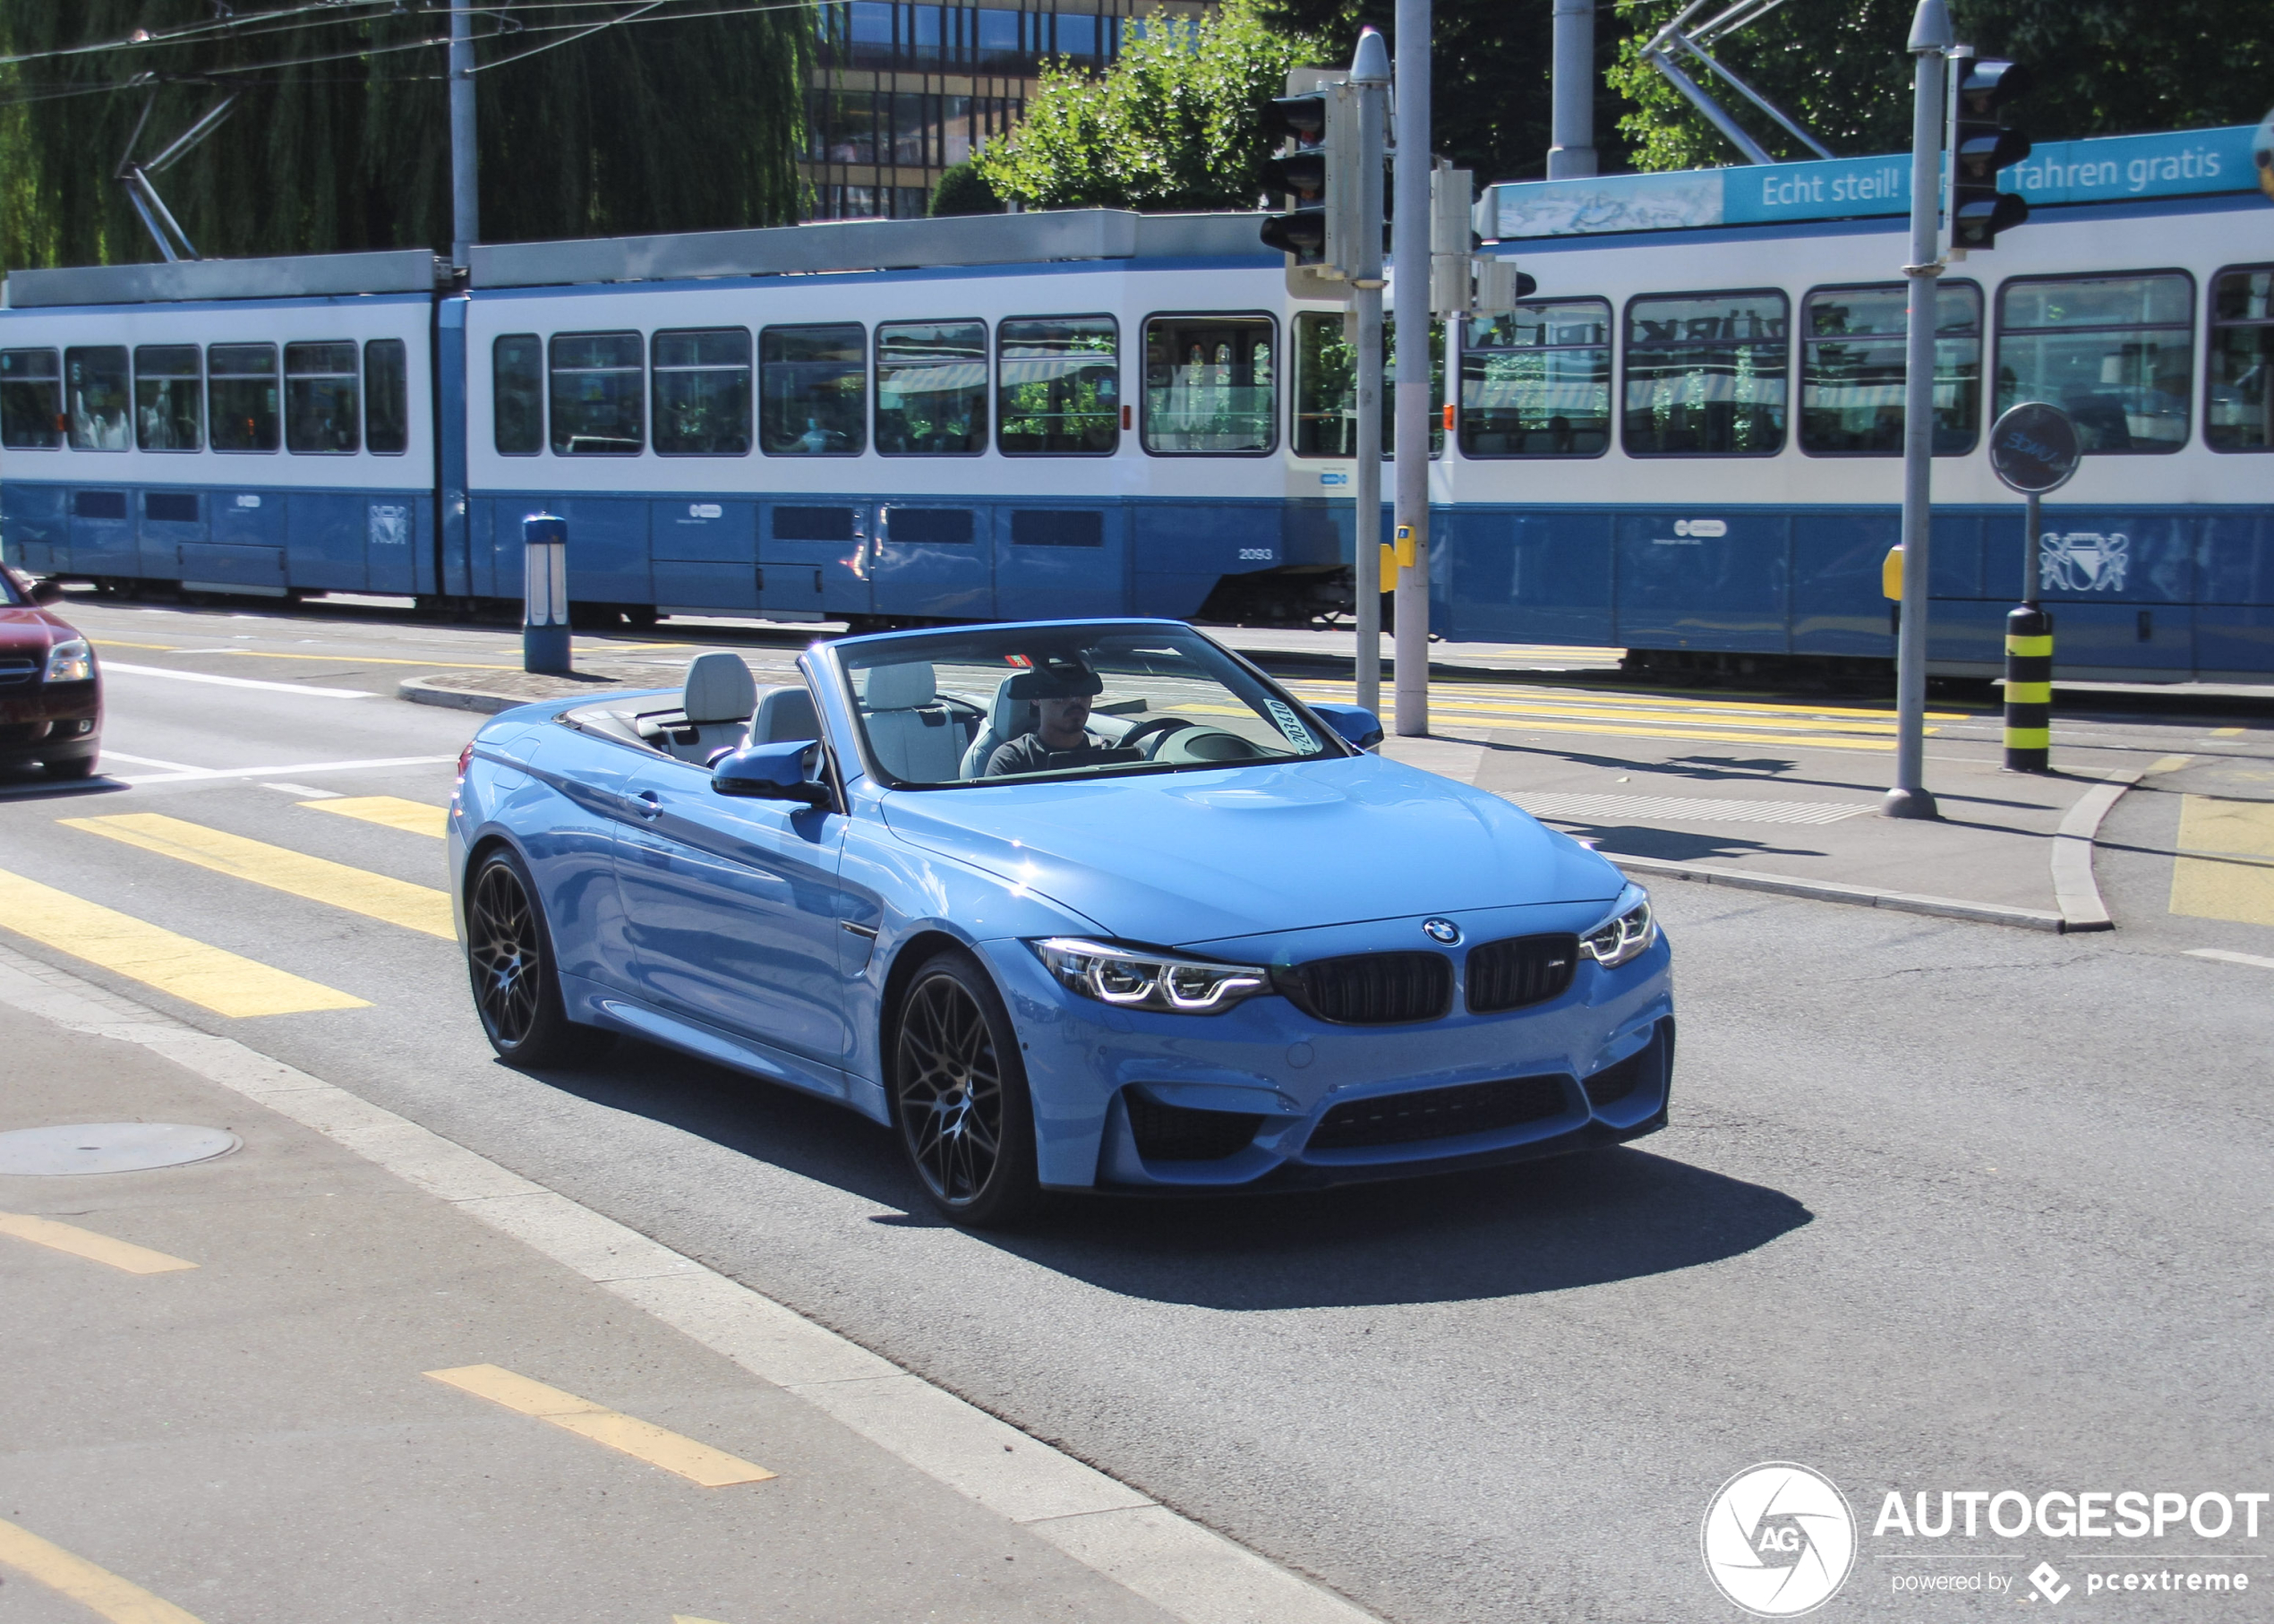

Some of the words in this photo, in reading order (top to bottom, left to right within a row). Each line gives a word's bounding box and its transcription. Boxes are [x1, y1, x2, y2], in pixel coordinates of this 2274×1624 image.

[1762, 174, 1825, 206] Echt
[1831, 167, 1900, 202] steil!
[2013, 155, 2118, 190] fahren
[2127, 147, 2222, 192] gratis
[1238, 548, 1273, 560] 2093
